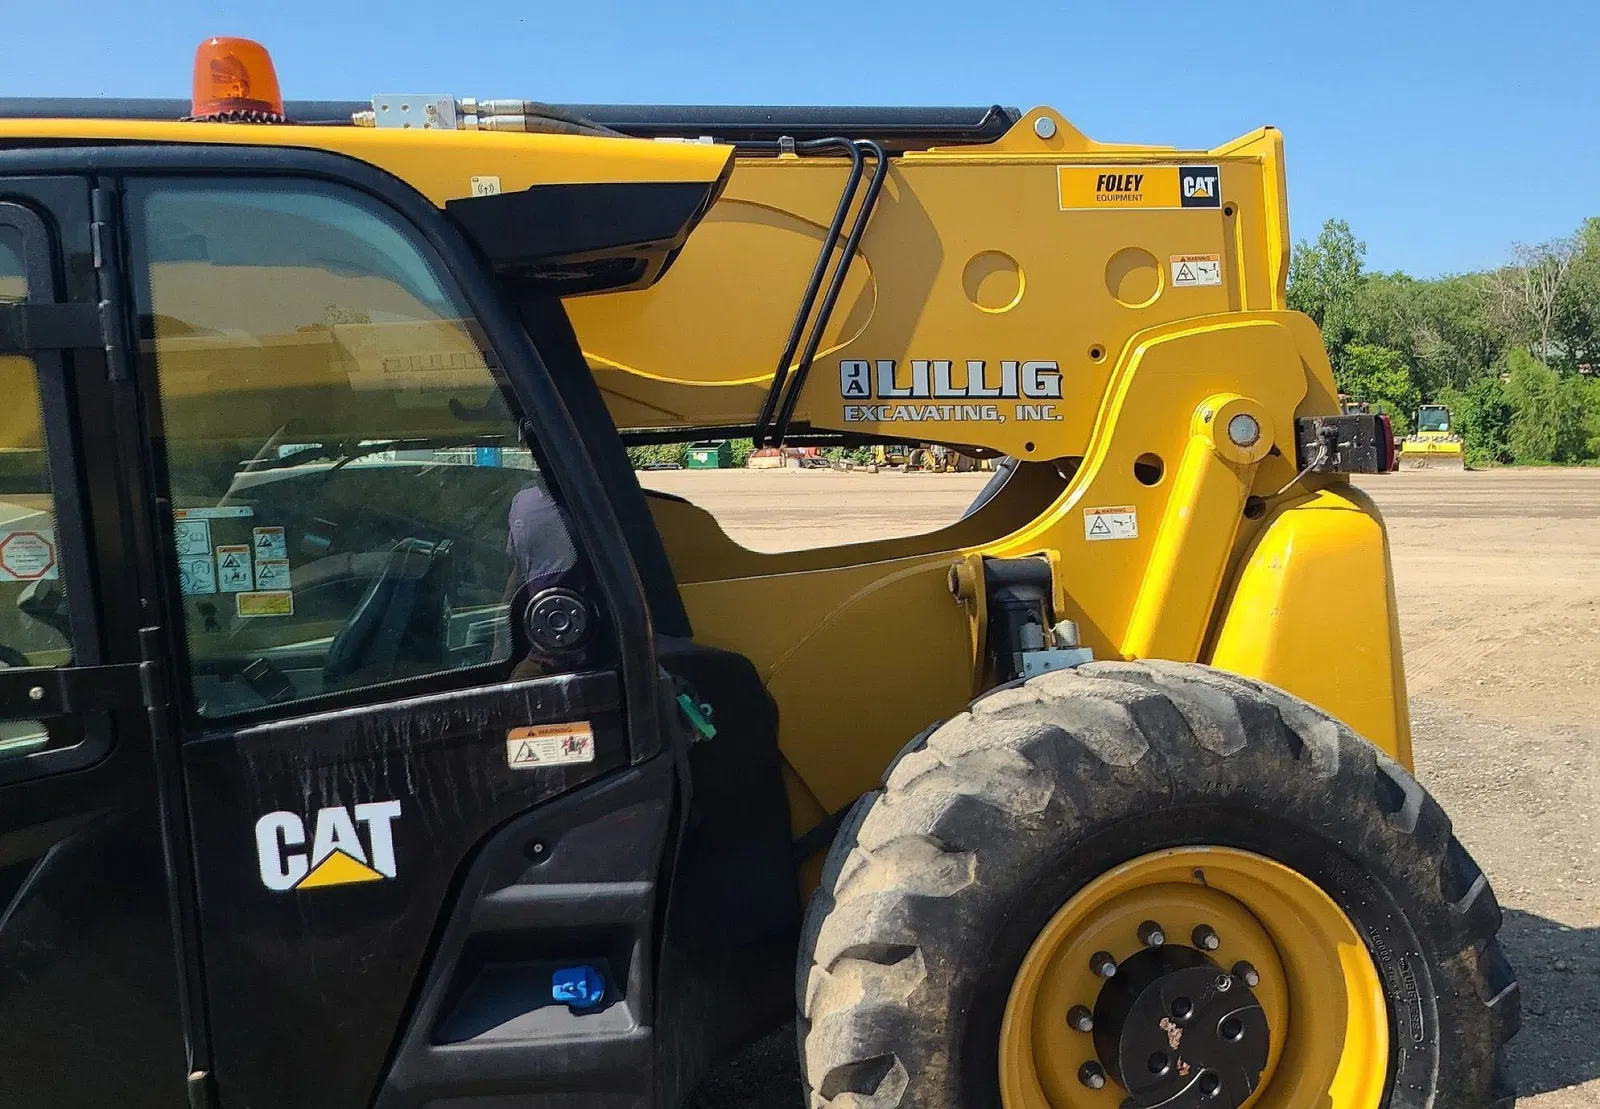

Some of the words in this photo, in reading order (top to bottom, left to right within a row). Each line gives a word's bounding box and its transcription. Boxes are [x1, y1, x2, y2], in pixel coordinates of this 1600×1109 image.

[1096, 174, 1144, 192] FOLEY
[1183, 176, 1217, 197] CAT
[1096, 194, 1144, 202] EQUIPMENT
[876, 360, 1063, 399] LILLIG
[843, 404, 1006, 423] EXCAVATING,
[1015, 404, 1064, 421] INC.
[255, 799, 402, 890] CAT
